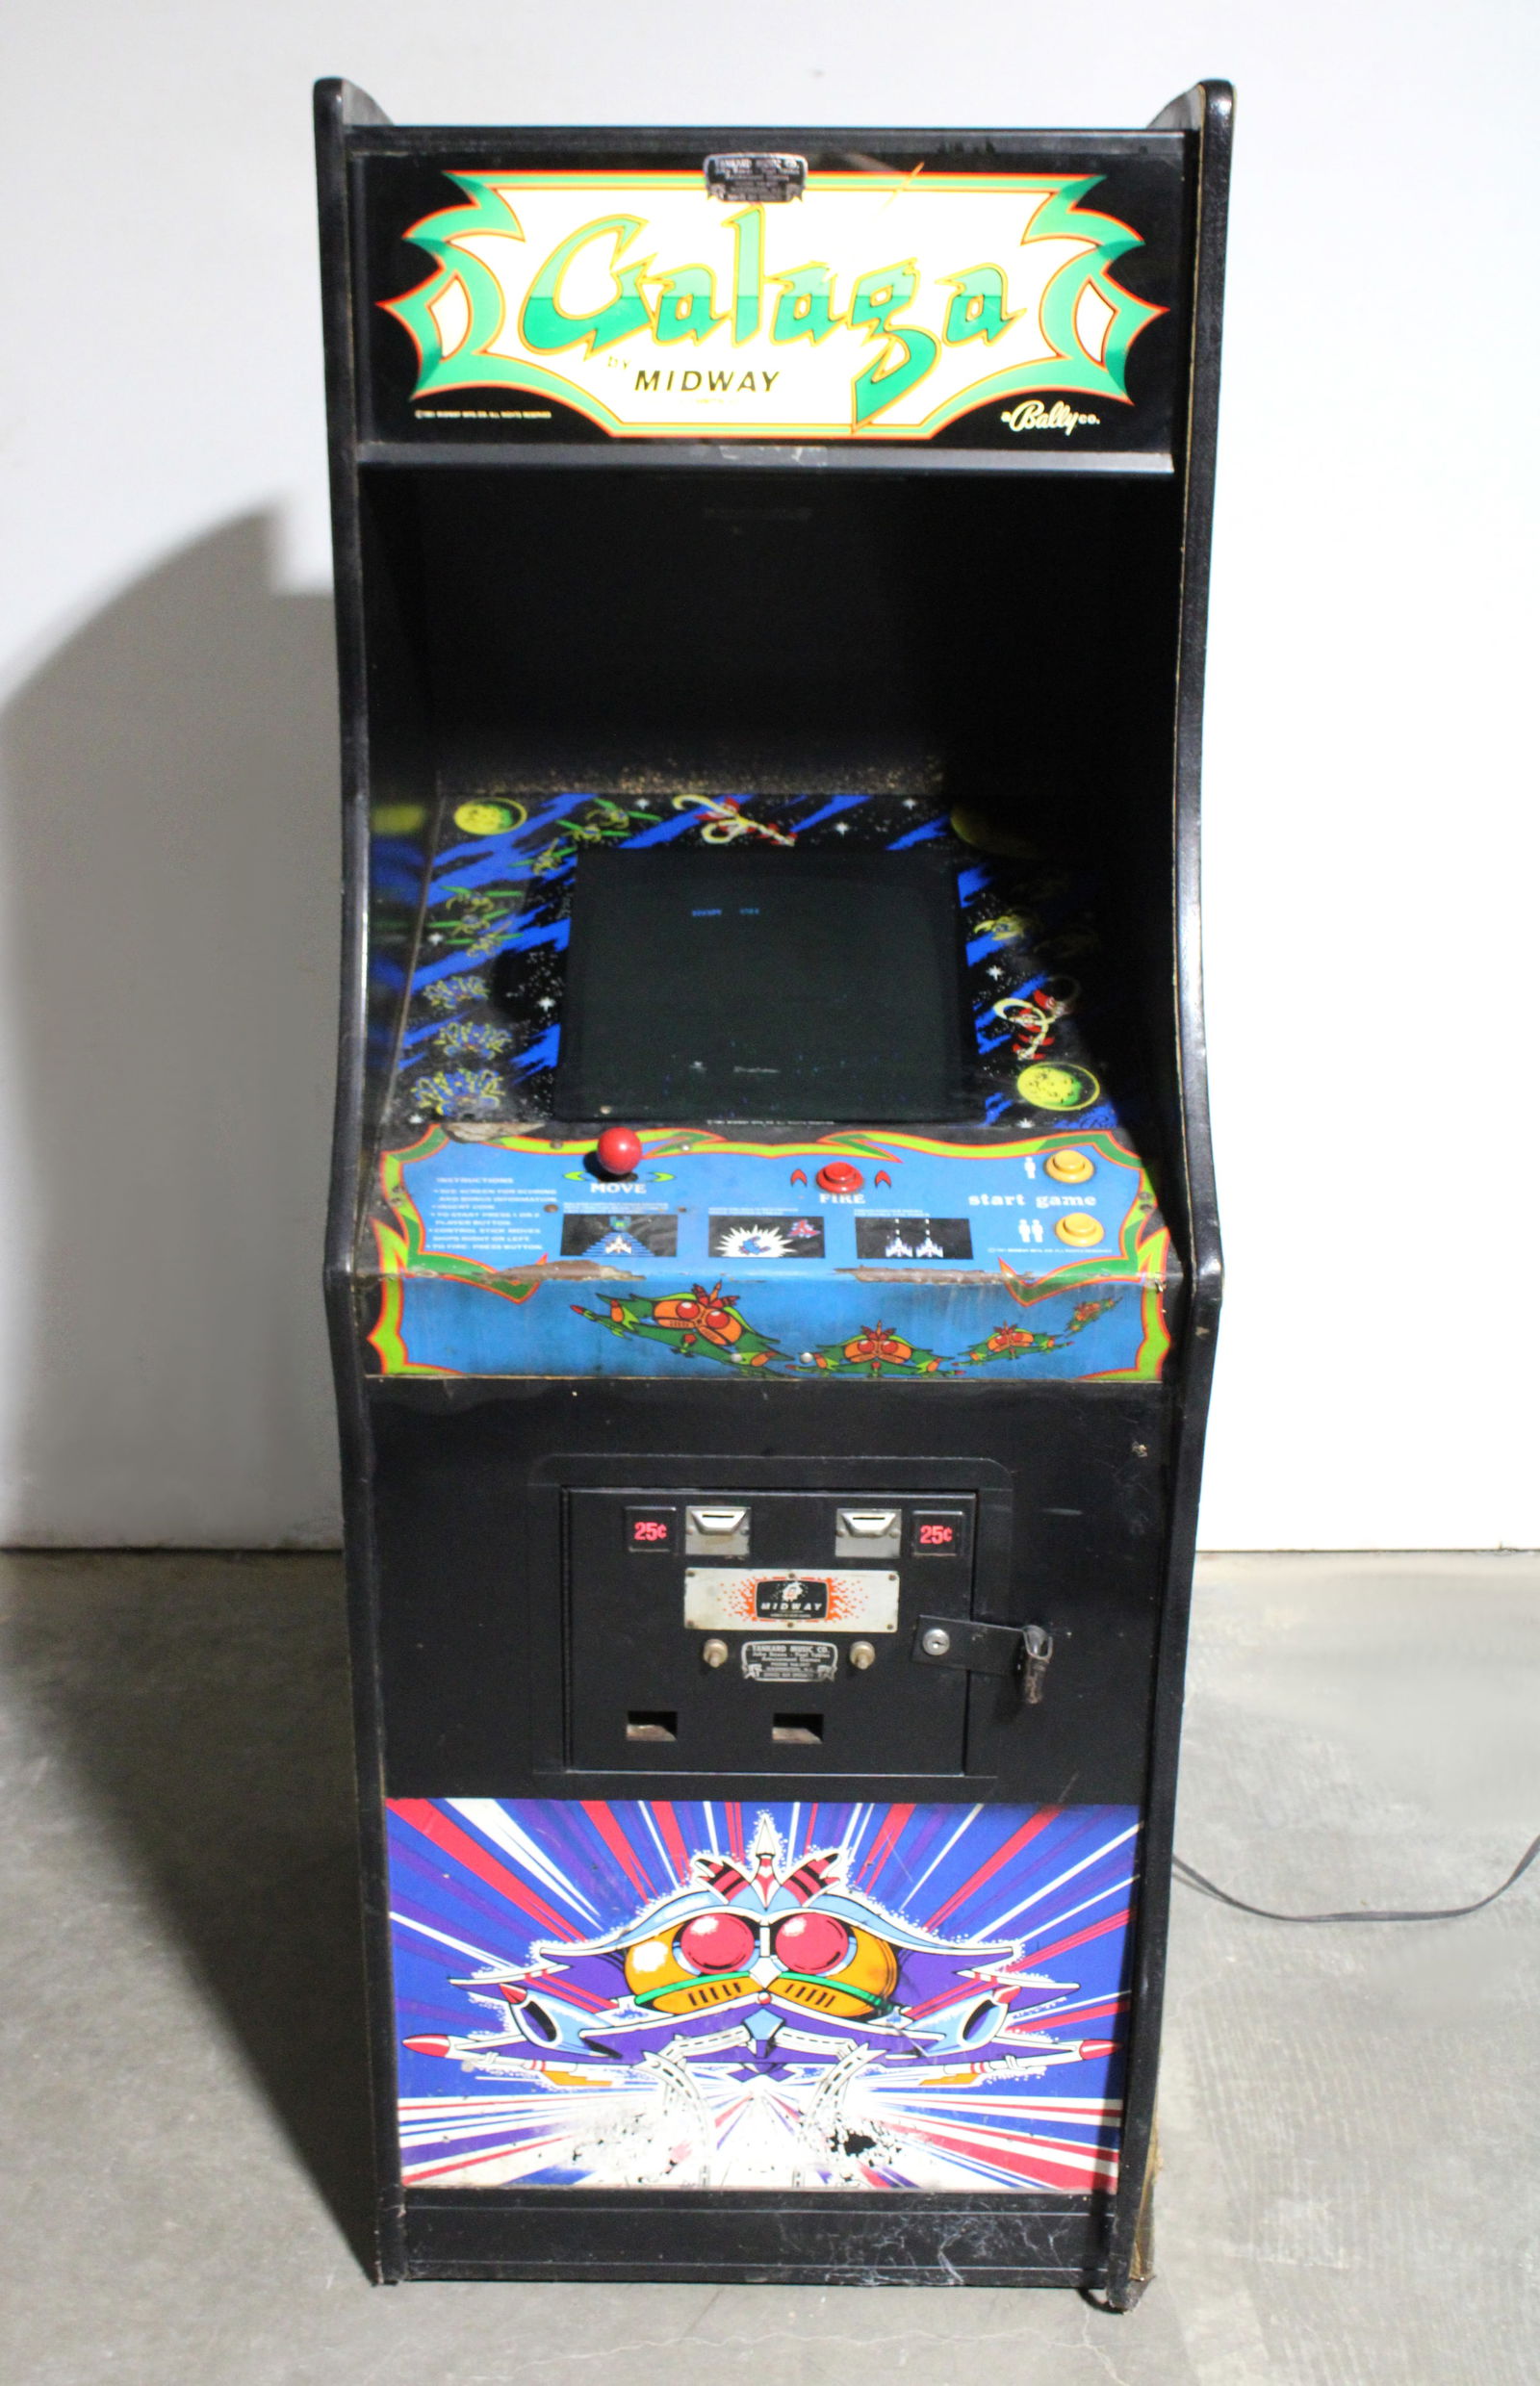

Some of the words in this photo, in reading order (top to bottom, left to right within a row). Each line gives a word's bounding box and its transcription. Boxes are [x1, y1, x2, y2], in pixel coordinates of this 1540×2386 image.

[518, 204, 1027, 434] Galaga
[634, 370, 781, 392] MIDWAY
[1009, 399, 1079, 436] Bally
[590, 1182, 647, 1193] MOVE
[820, 1193, 866, 1204] FIRE
[968, 1193, 1026, 1206] start
[1036, 1195, 1096, 1209] game
[633, 1522, 667, 1541] 25¢
[920, 1525, 953, 1545] 25¢
[760, 1602, 823, 1610] MIDWAY
